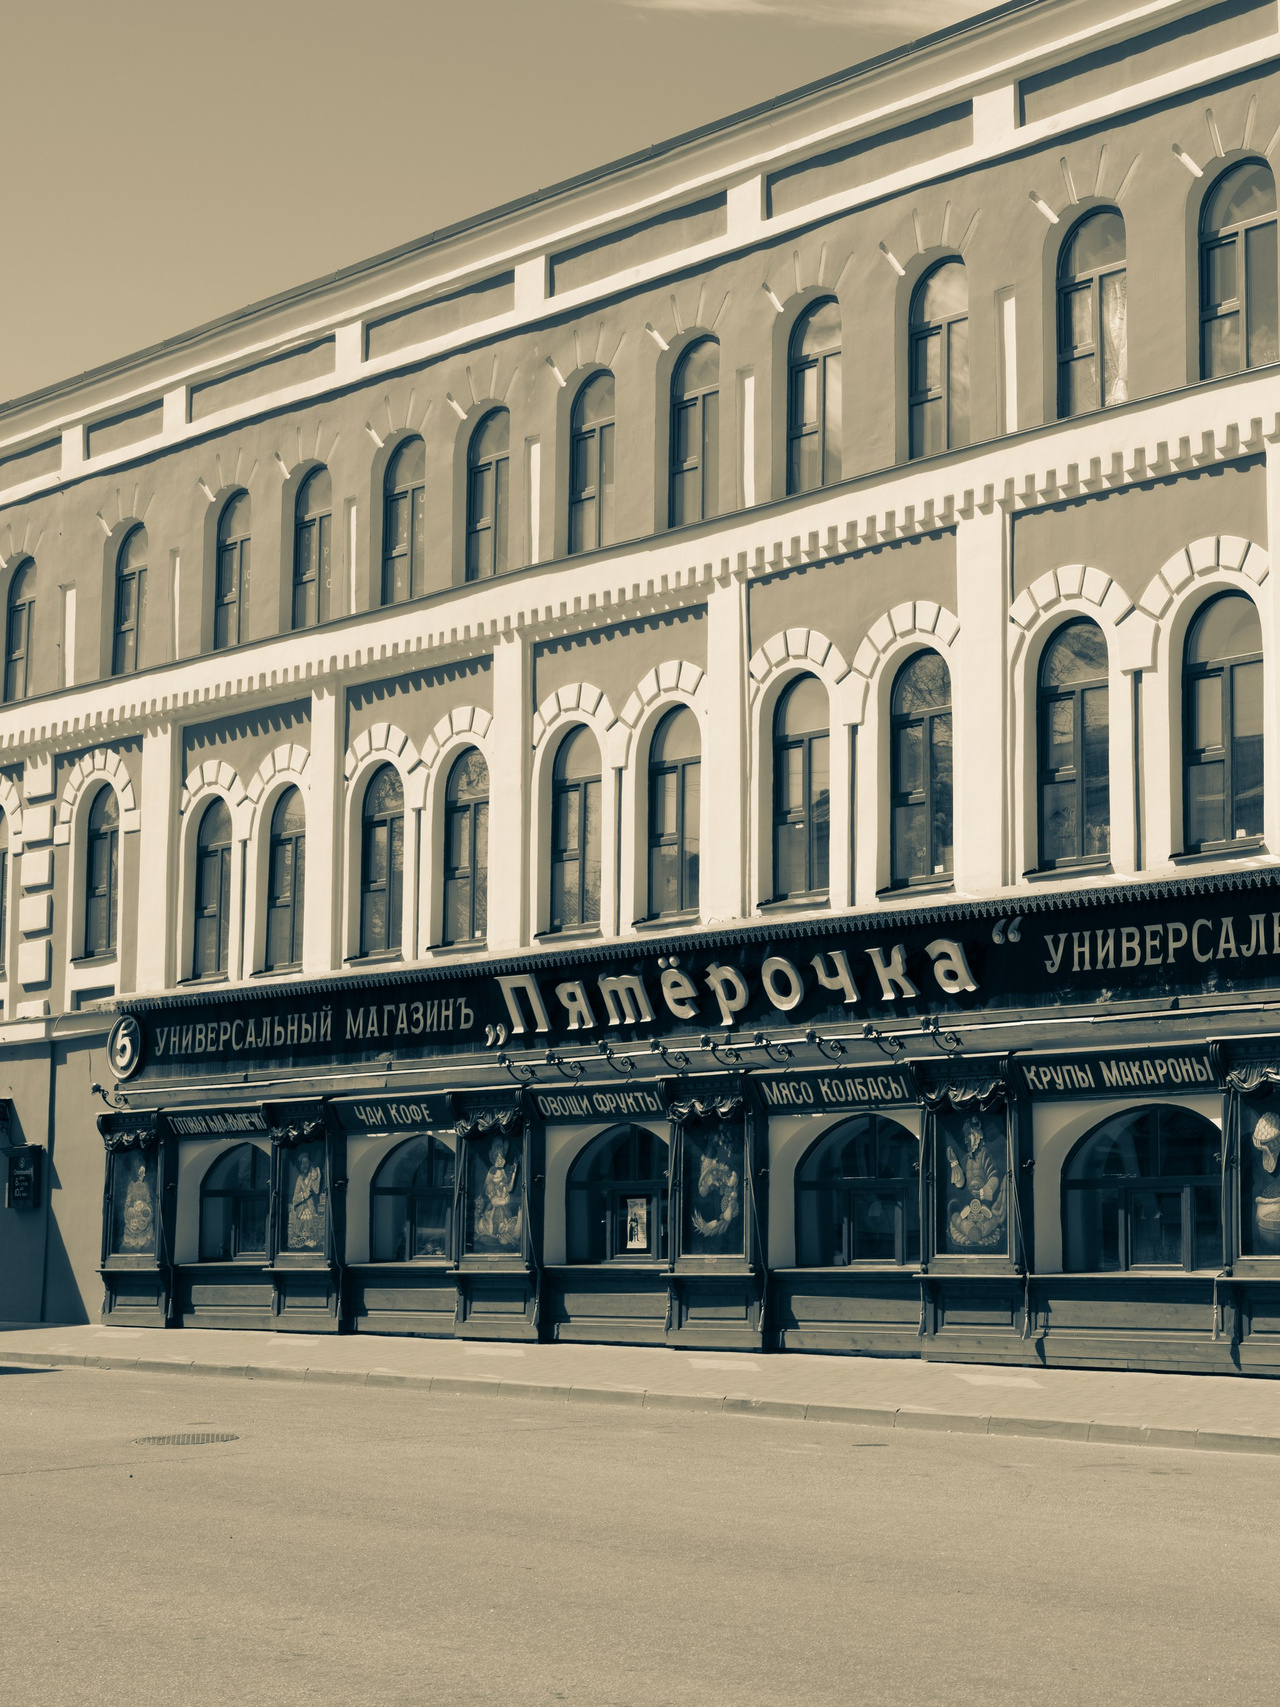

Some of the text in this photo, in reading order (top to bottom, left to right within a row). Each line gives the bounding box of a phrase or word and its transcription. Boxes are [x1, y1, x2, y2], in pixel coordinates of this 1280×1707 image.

[154, 997, 475, 1057] УНИВЕРСАЛЬНЫЙ МАГАЗИНЪ
[1022, 1056, 1214, 1091] КРУПЫ МАКАРОНЫ
[537, 1091, 664, 1117] ОВОЩИ ФРУКТЫ
[761, 1075, 909, 1105] МЯСО КОЛБАСЫ
[166, 1116, 210, 1134] ГОТОВАЯ
[386, 1103, 434, 1124] КОФЕ
